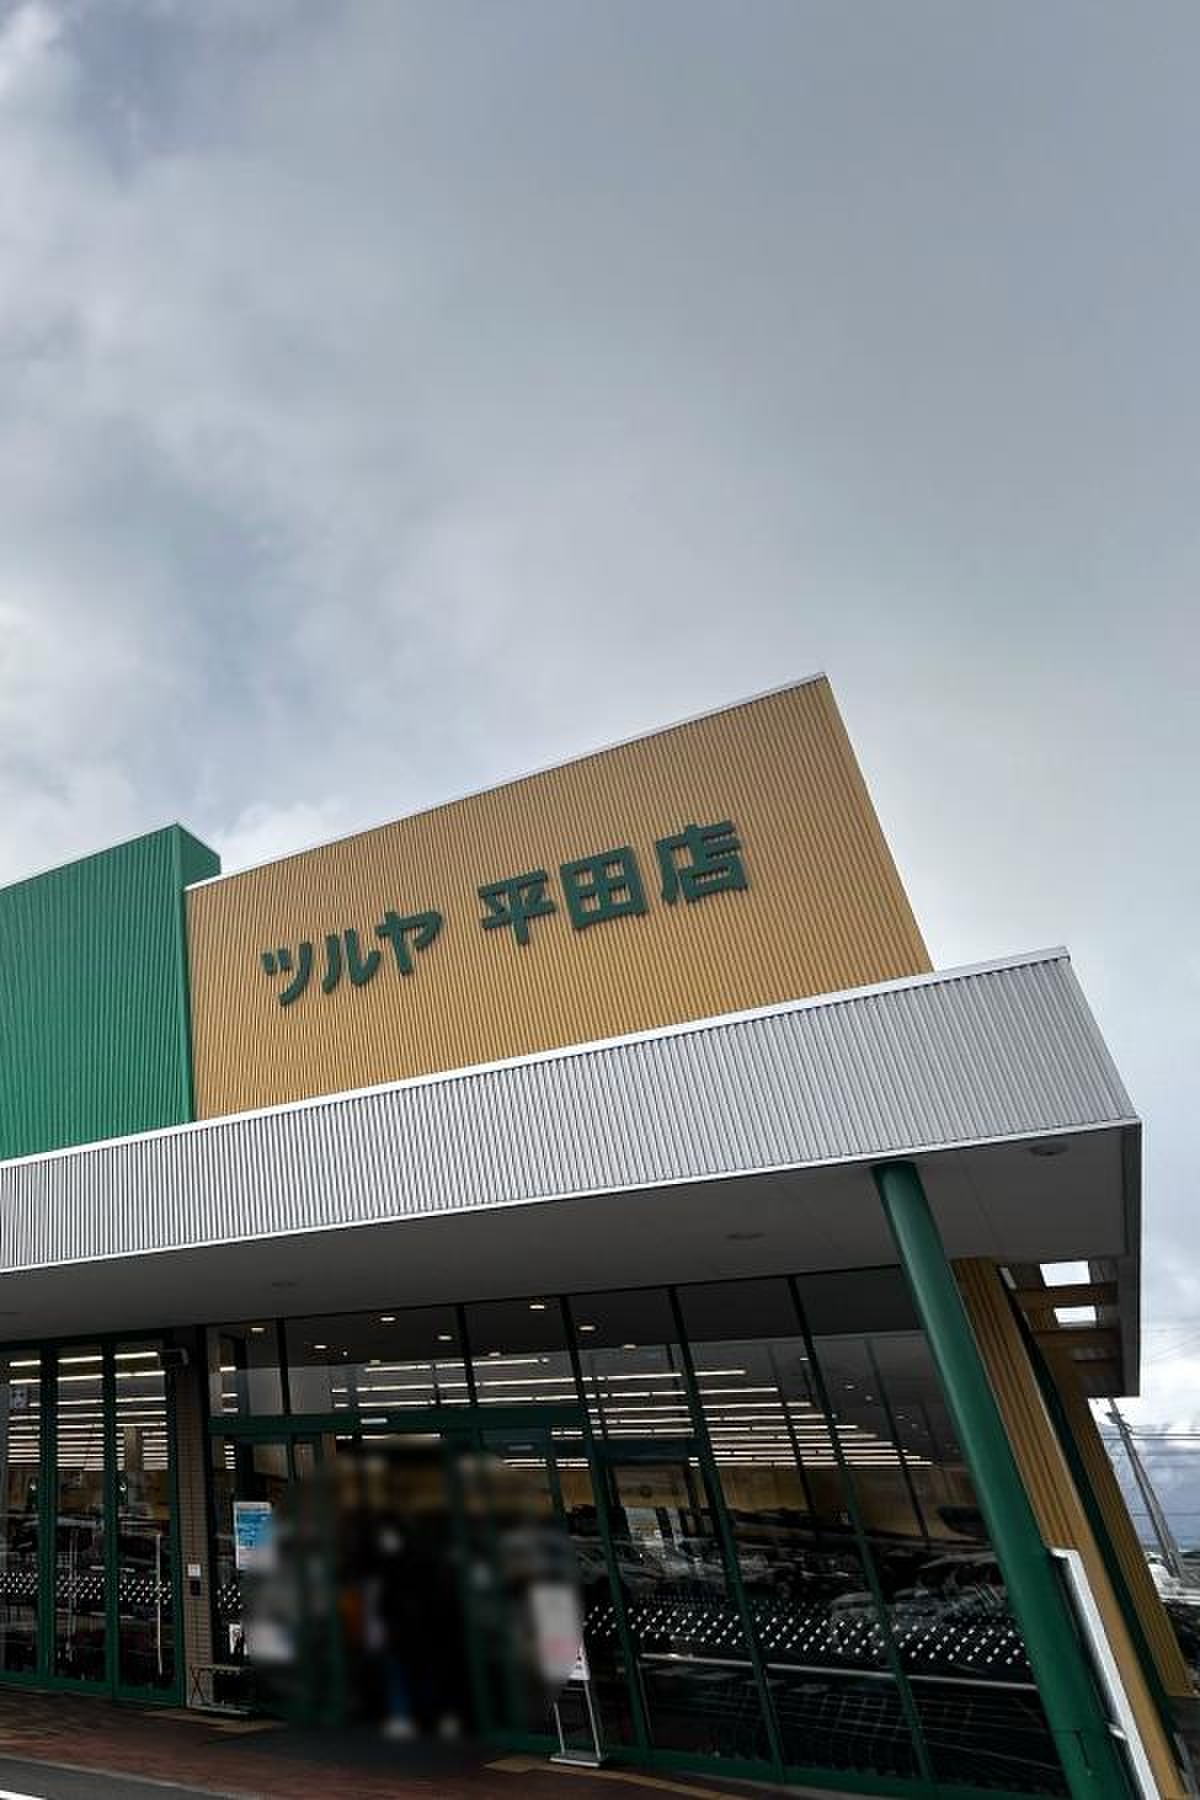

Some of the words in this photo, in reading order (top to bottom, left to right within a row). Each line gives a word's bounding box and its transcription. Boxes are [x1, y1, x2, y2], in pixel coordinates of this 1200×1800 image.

[260, 908, 443, 1007] ツルヤ
[477, 819, 748, 947] 平田店
